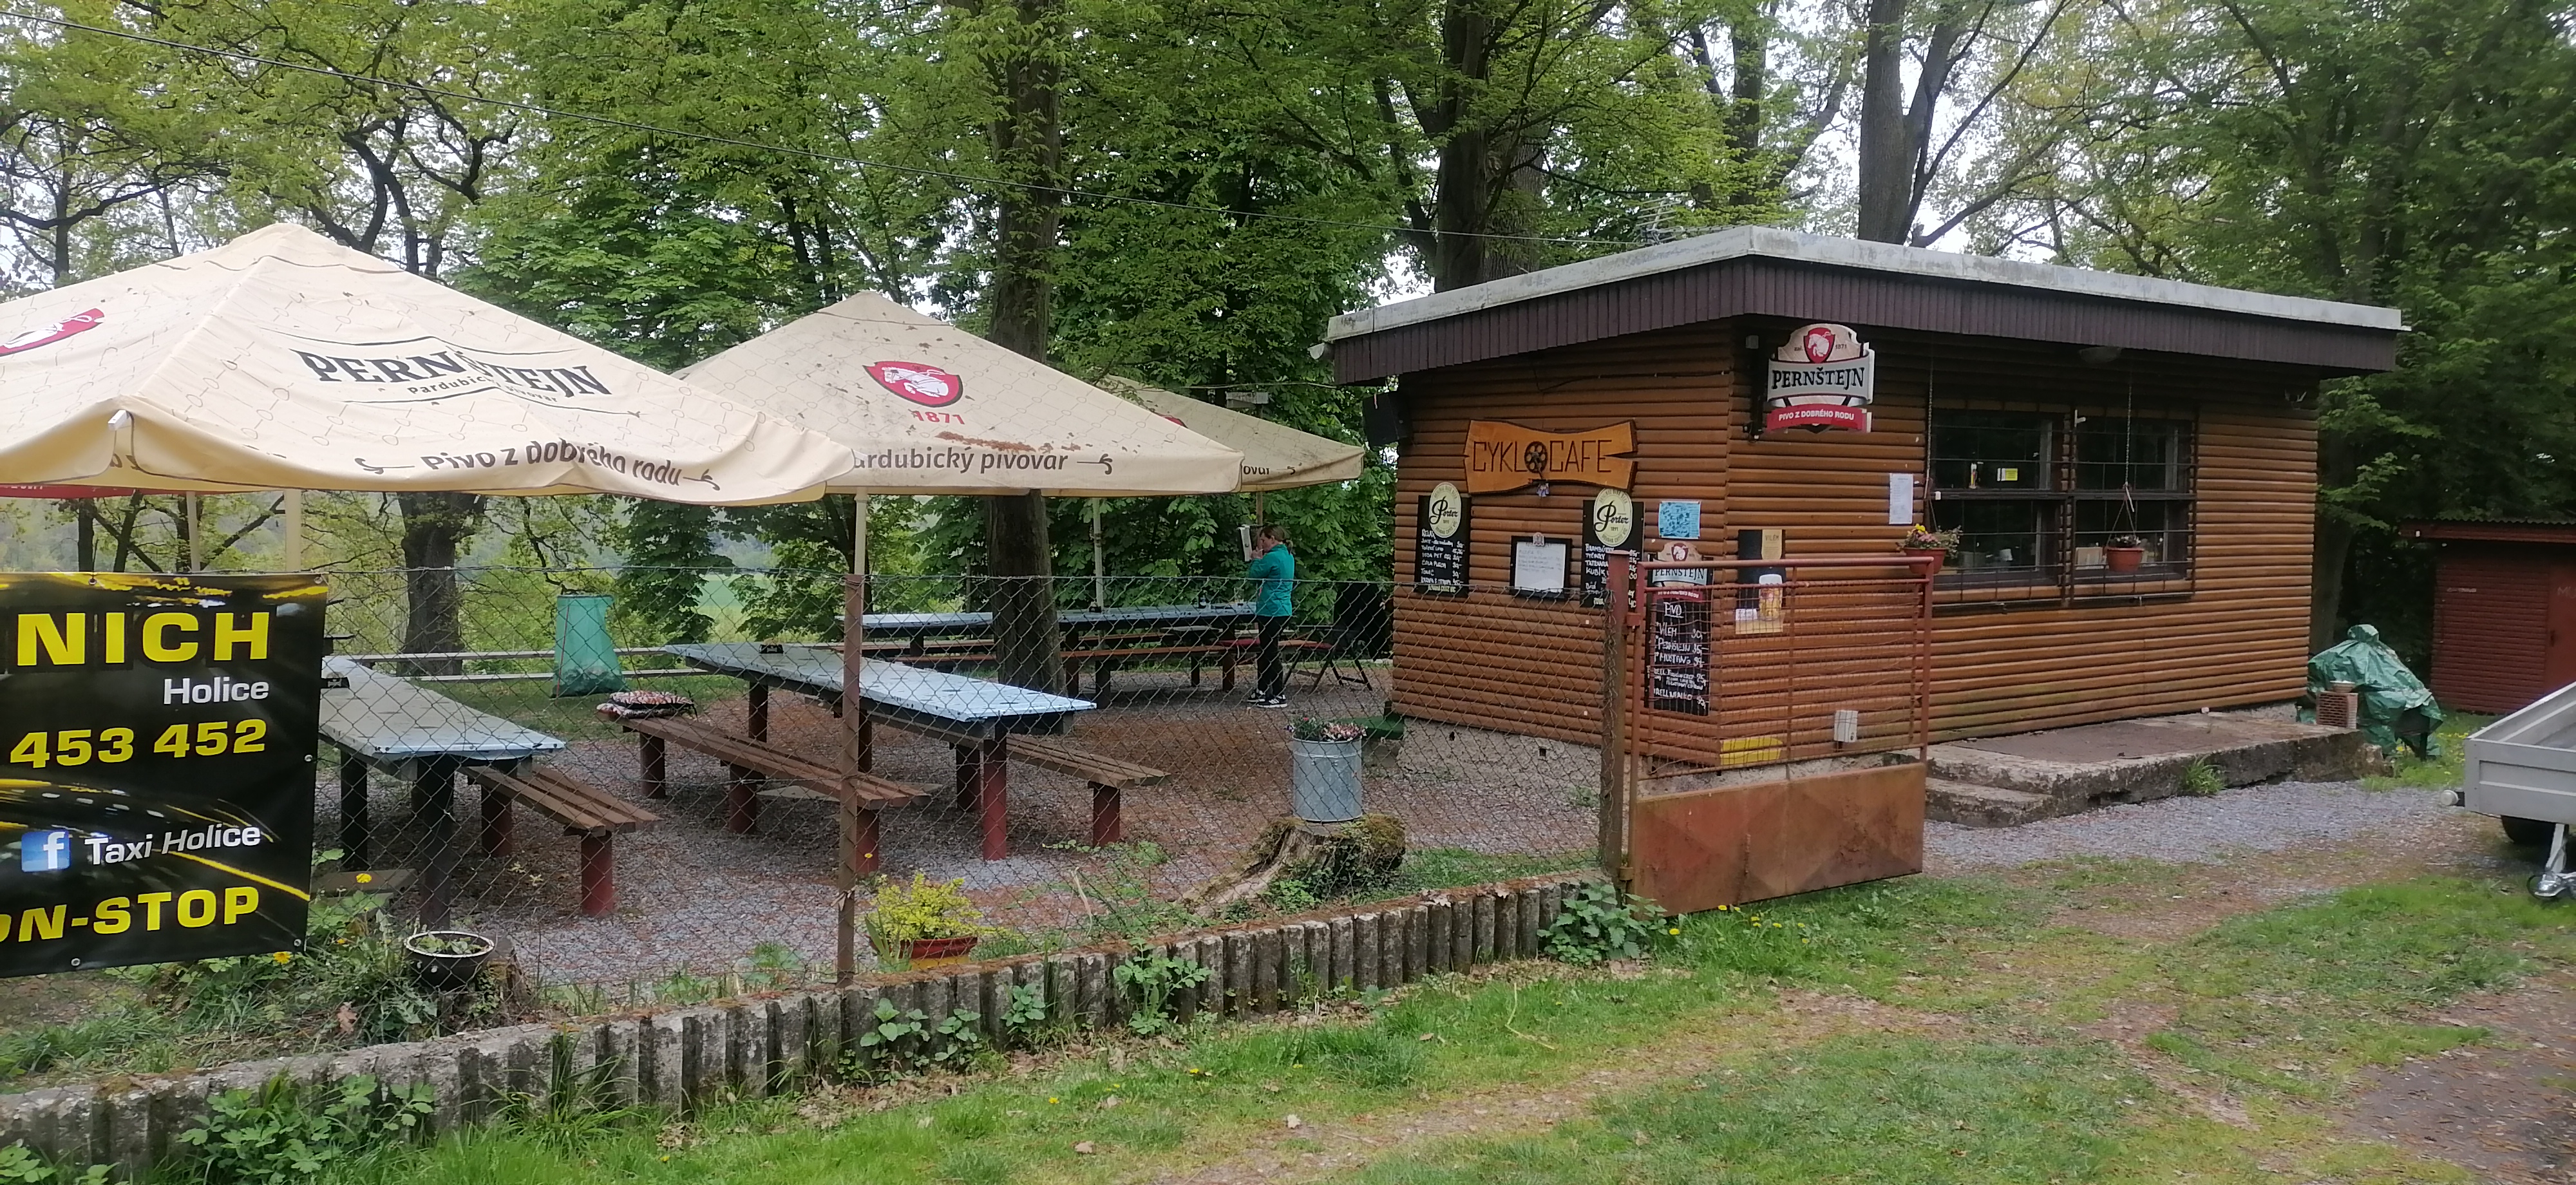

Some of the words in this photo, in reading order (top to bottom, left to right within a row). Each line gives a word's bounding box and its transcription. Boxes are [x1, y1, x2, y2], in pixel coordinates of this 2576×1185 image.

[1771, 366, 1865, 391] PERNŠTEJN
[913, 410, 966, 425] 1871
[1779, 412, 1794, 422] PIVO
[1801, 408, 1834, 418] DOBRÉHO
[1835, 411, 1855, 421] RODU
[420, 451, 497, 471] Pivo
[500, 448, 518, 466] z
[632, 460, 683, 486] rodu
[854, 446, 974, 474] ardubický
[980, 452, 1069, 474] pivovar
[1243, 465, 1270, 475] ovar
[1429, 495, 1459, 525] Porter
[1594, 500, 1629, 533] Porter
[17, 611, 270, 667] NICH
[163, 676, 269, 705] Holice
[10, 726, 134, 769] 453
[153, 718, 267, 759] 452
[84, 834, 153, 866] Taxi
[161, 824, 261, 855] Holice
